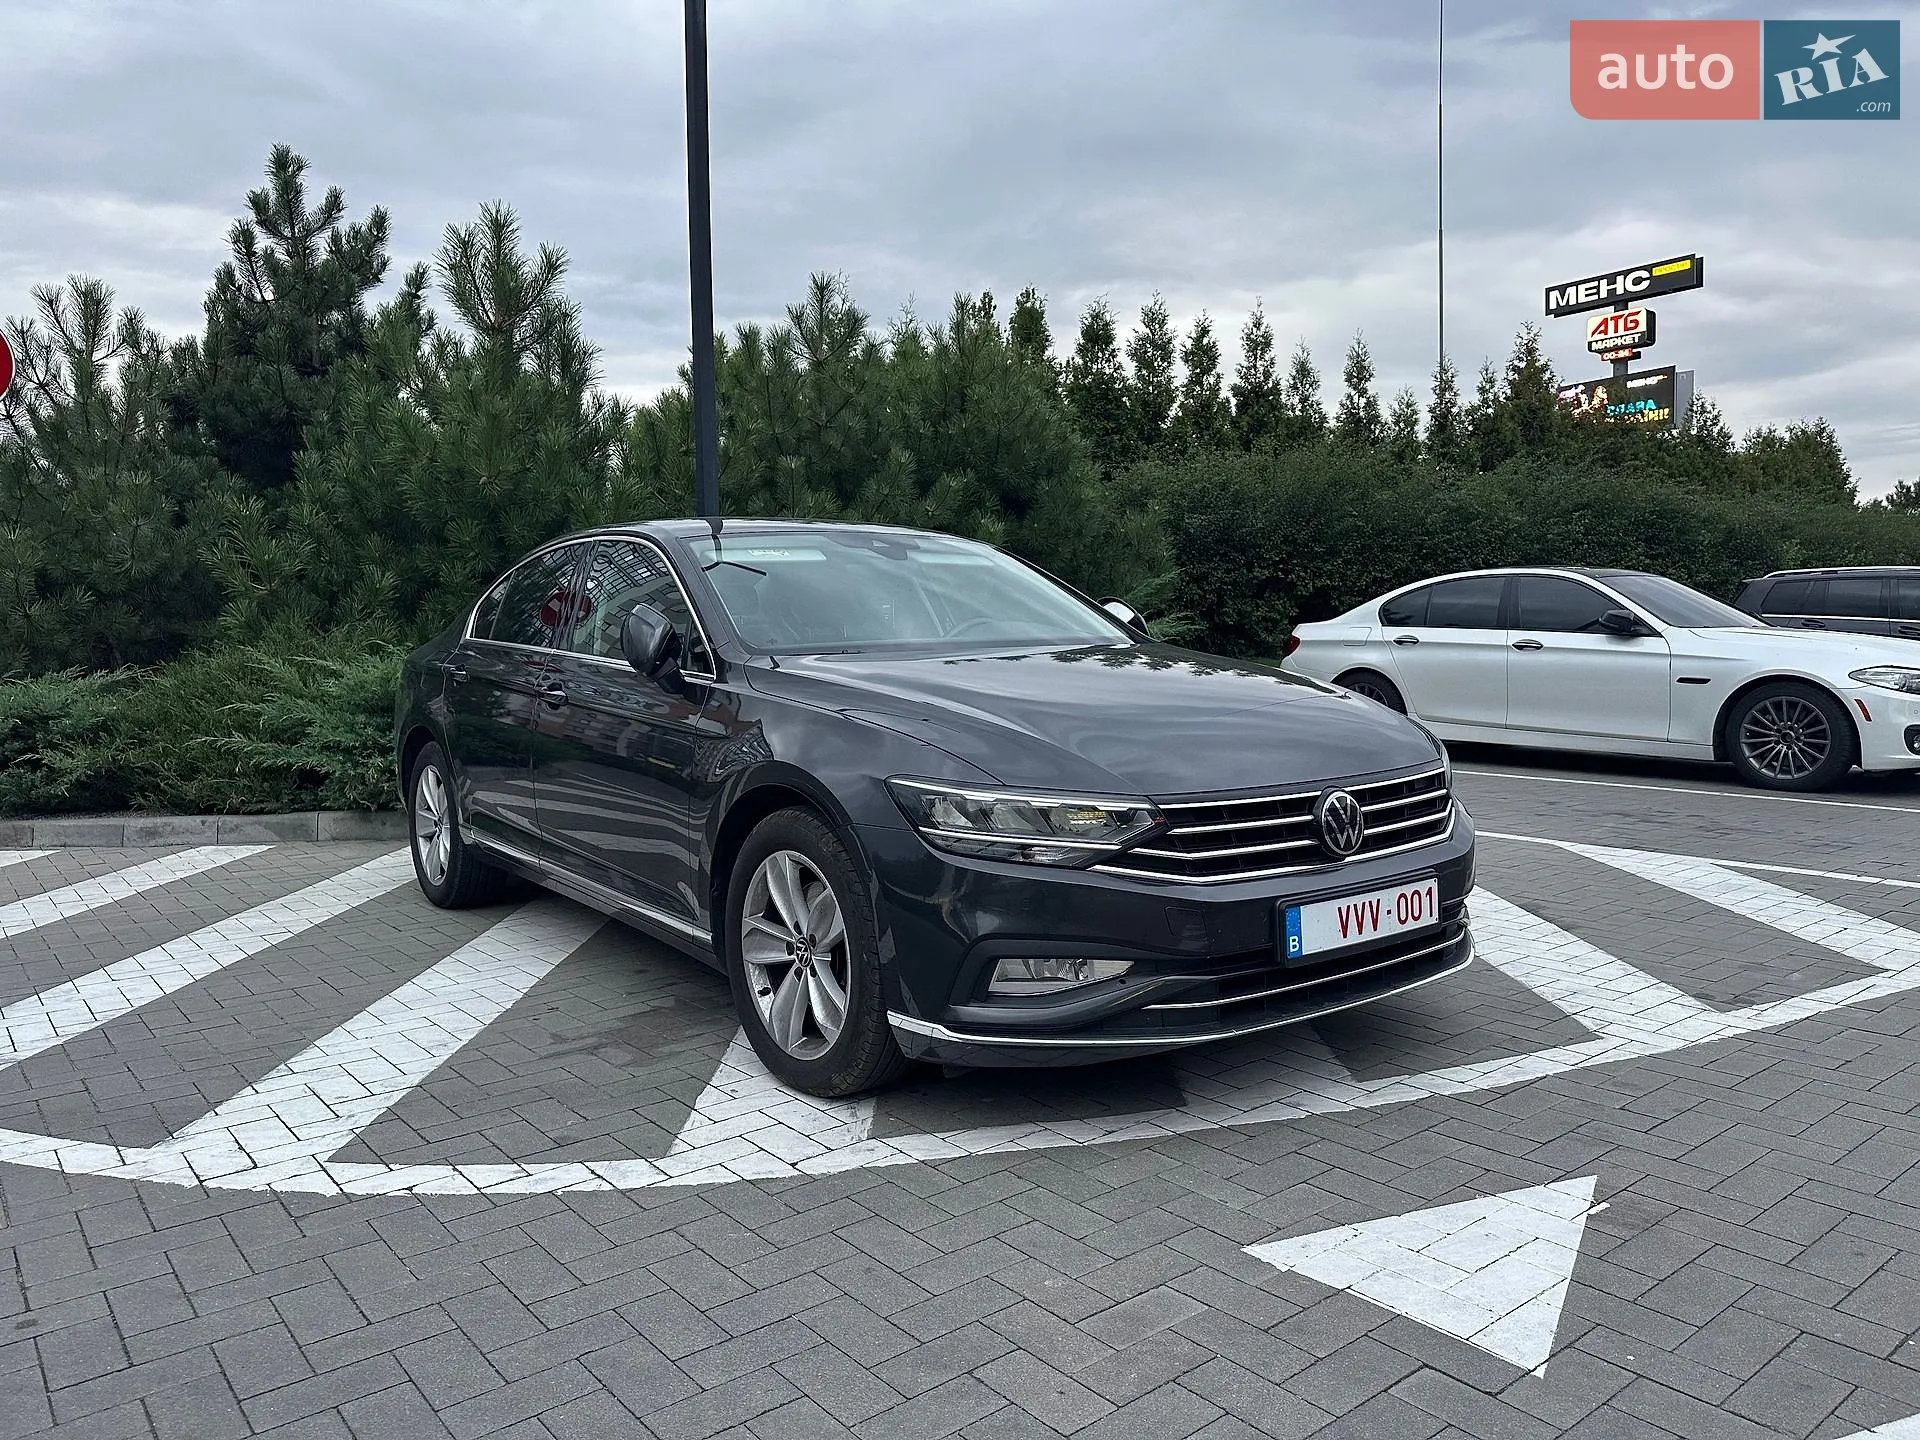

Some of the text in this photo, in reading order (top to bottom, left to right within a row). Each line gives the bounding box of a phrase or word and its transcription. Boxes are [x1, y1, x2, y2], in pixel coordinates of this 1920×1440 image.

[1549, 270, 1650, 310] МЕНС
[1591, 332, 1641, 351] МАРКЕТ
[1289, 935, 1300, 952] B
